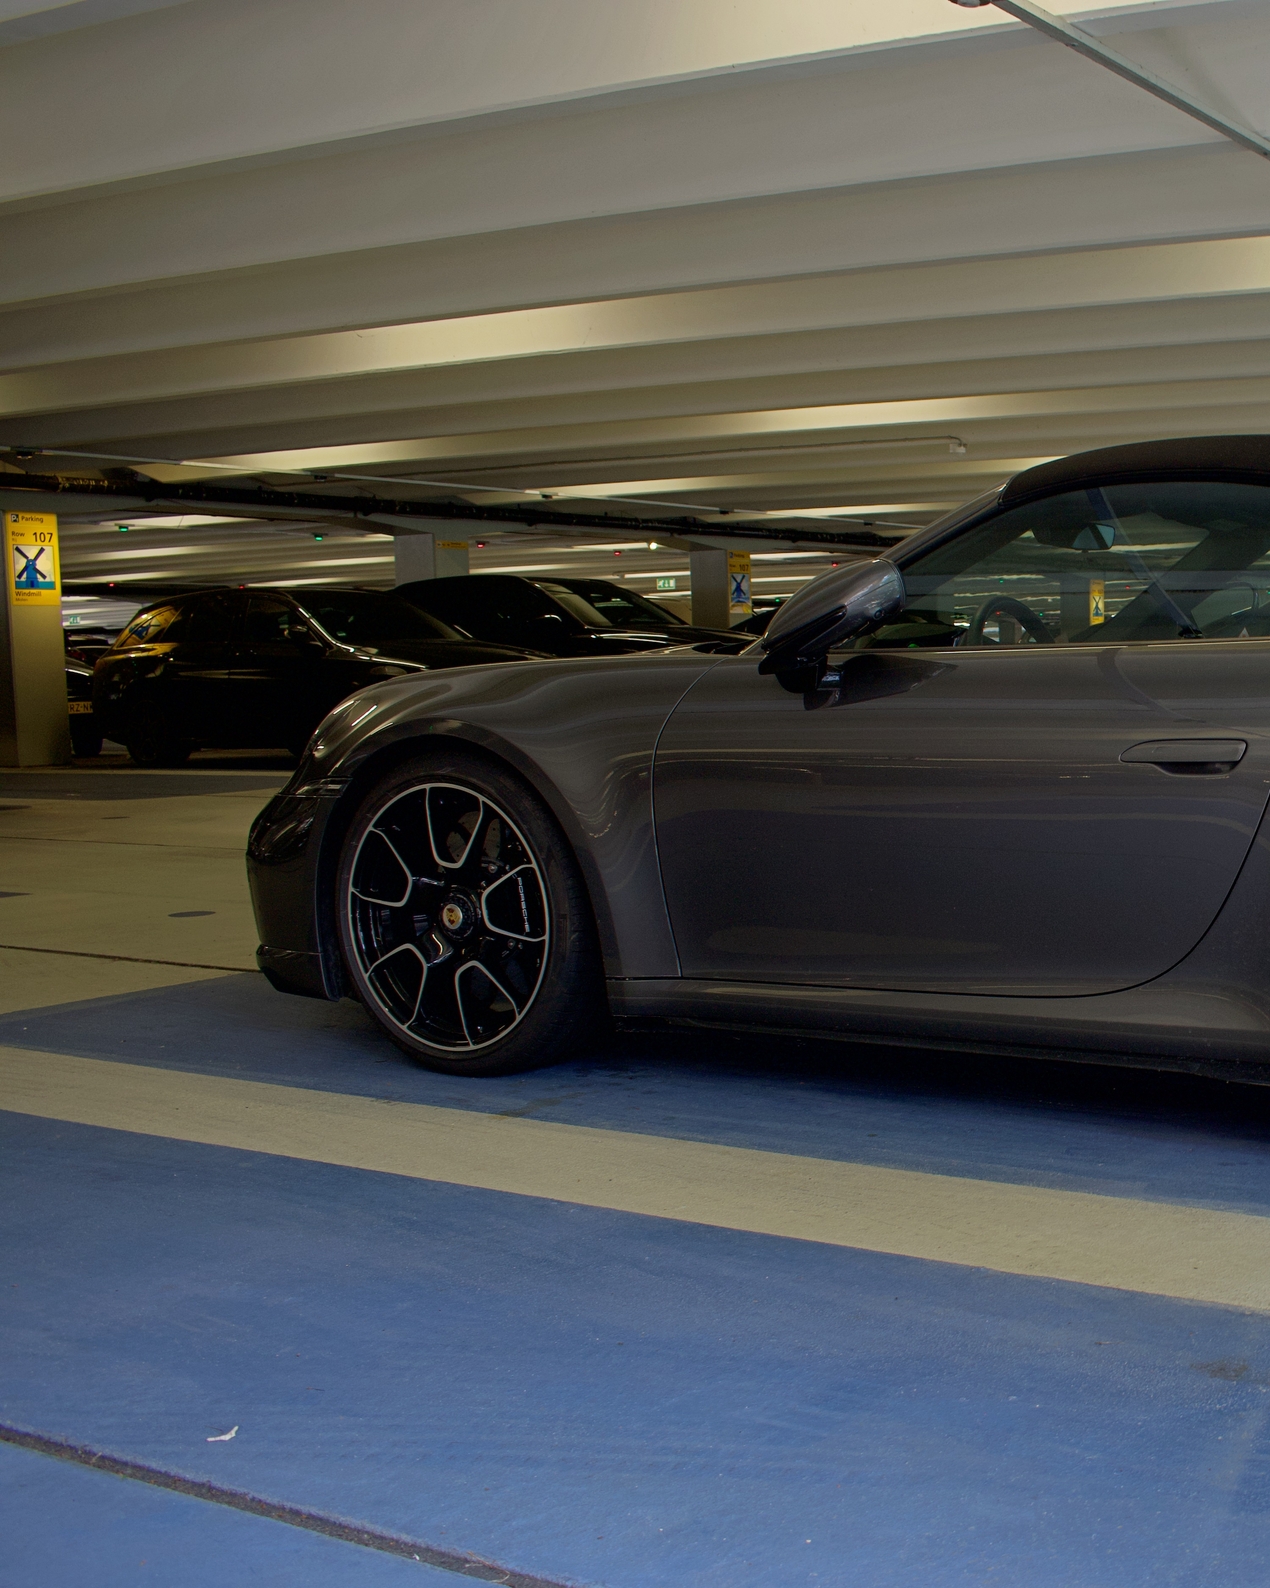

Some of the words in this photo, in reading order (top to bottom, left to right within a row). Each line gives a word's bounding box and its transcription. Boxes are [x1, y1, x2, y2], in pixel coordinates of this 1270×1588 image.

[21, 515, 44, 523] Parking
[32, 532, 53, 543] 107
[516, 876, 531, 933] PORSCHE
